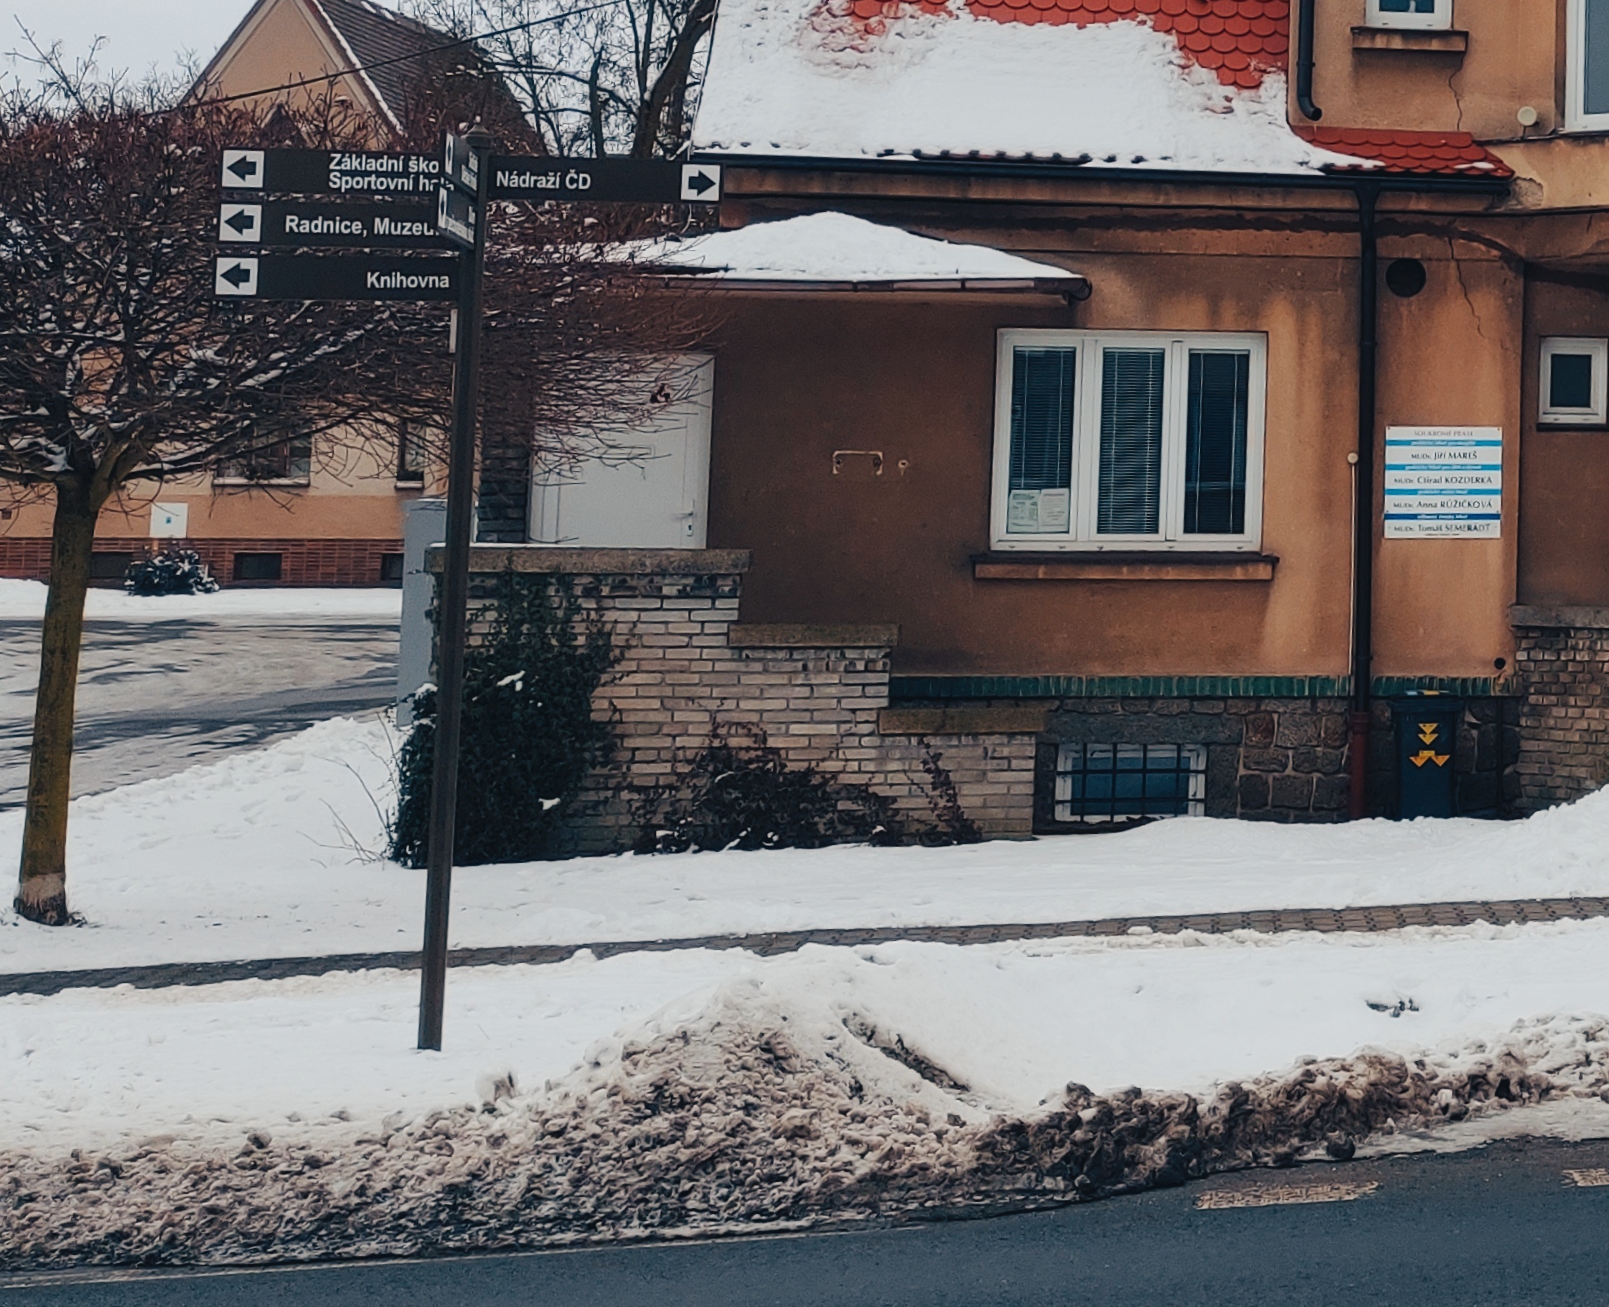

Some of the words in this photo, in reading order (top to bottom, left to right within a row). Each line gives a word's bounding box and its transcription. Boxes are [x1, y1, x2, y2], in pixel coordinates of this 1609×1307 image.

[329, 153, 404, 173] Základní
[408, 155, 439, 174] ško
[328, 172, 416, 193] Sportovní
[496, 170, 562, 190] Nádraží
[565, 168, 592, 190] ČD
[285, 215, 368, 237] Radnice,
[374, 217, 440, 236] Muzeu
[366, 271, 450, 289] Knihovna
[1448, 450, 1478, 460] MAREŠ
[1417, 475, 1443, 484] Ctirad
[1444, 476, 1493, 484] KOZDERKA
[1416, 500, 1438, 509] Anna
